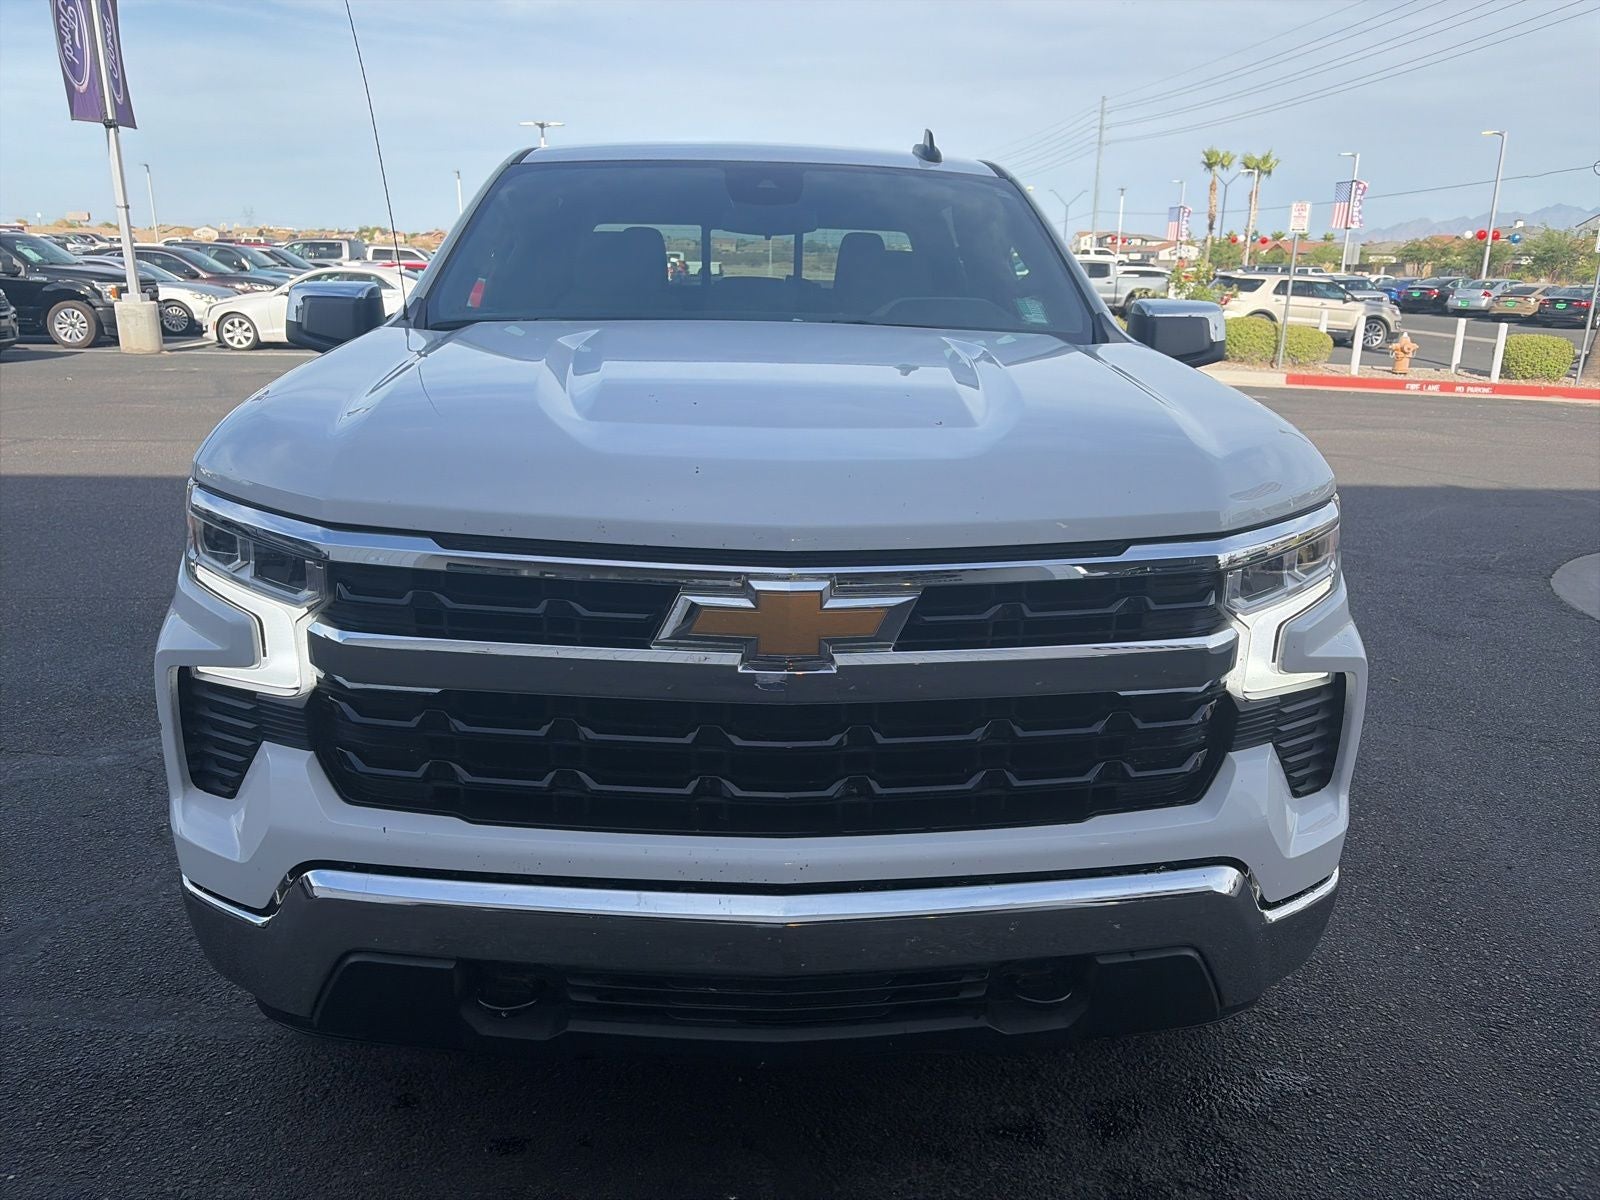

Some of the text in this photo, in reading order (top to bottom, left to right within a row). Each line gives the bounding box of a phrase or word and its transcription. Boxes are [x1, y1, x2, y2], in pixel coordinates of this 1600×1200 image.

[58, 0, 81, 65] Ford
[1405, 383, 1493, 394] FIRE LANE NO PARKING
